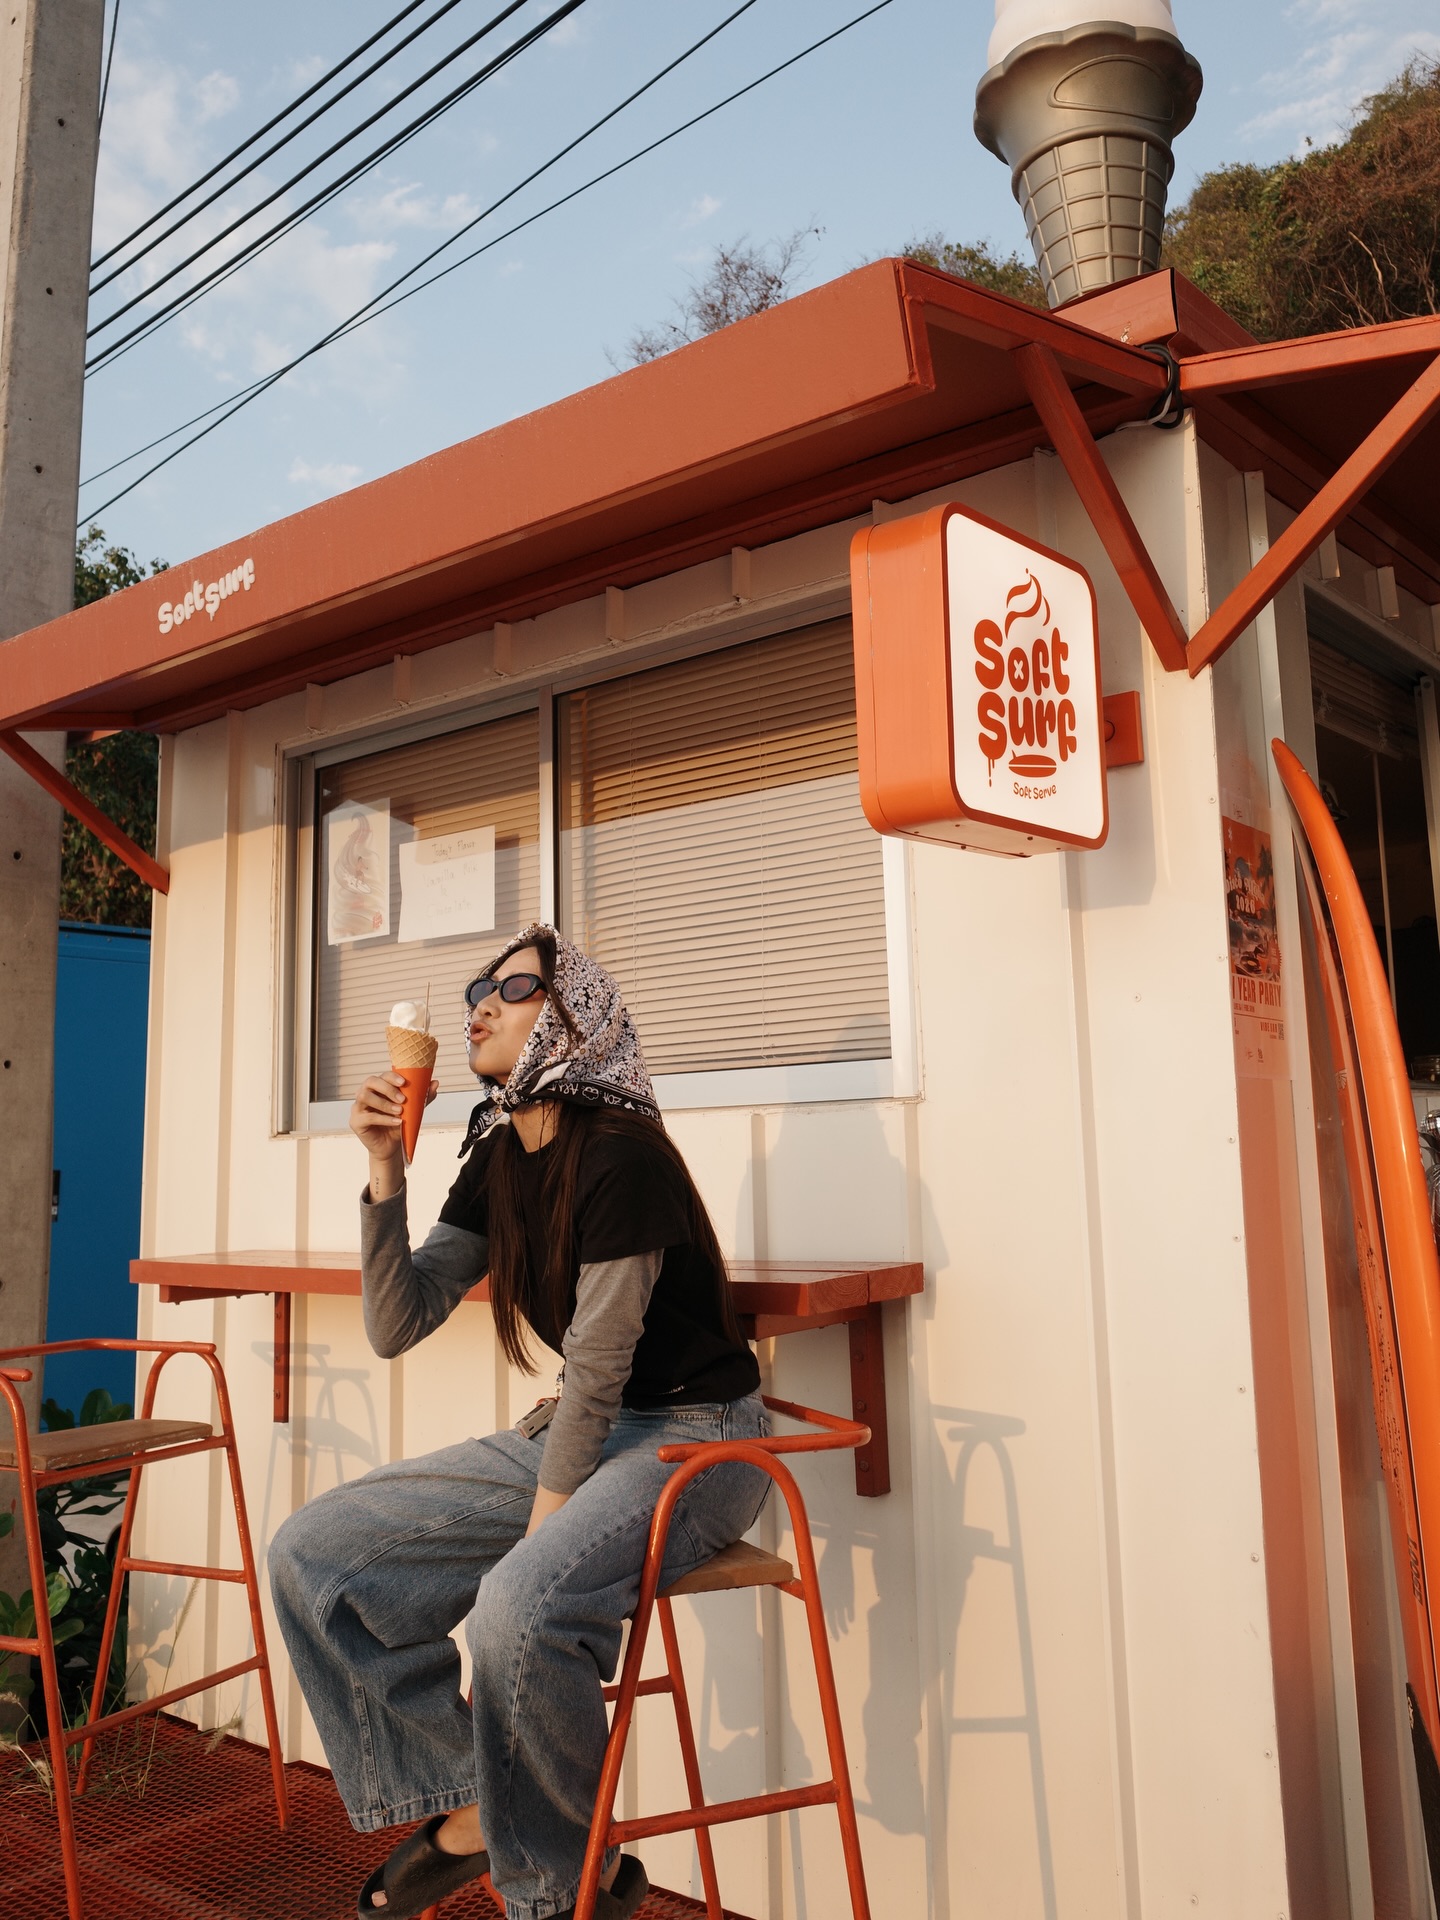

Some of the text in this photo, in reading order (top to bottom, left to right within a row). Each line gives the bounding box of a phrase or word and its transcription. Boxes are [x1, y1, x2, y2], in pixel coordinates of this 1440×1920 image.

[974, 619, 1070, 696] Soft
[977, 691, 1077, 762] Surf
[1013, 781, 1057, 800] Soft Serve
[1238, 976, 1256, 1003] YEAR
[1259, 981, 1282, 1007] PARTY
